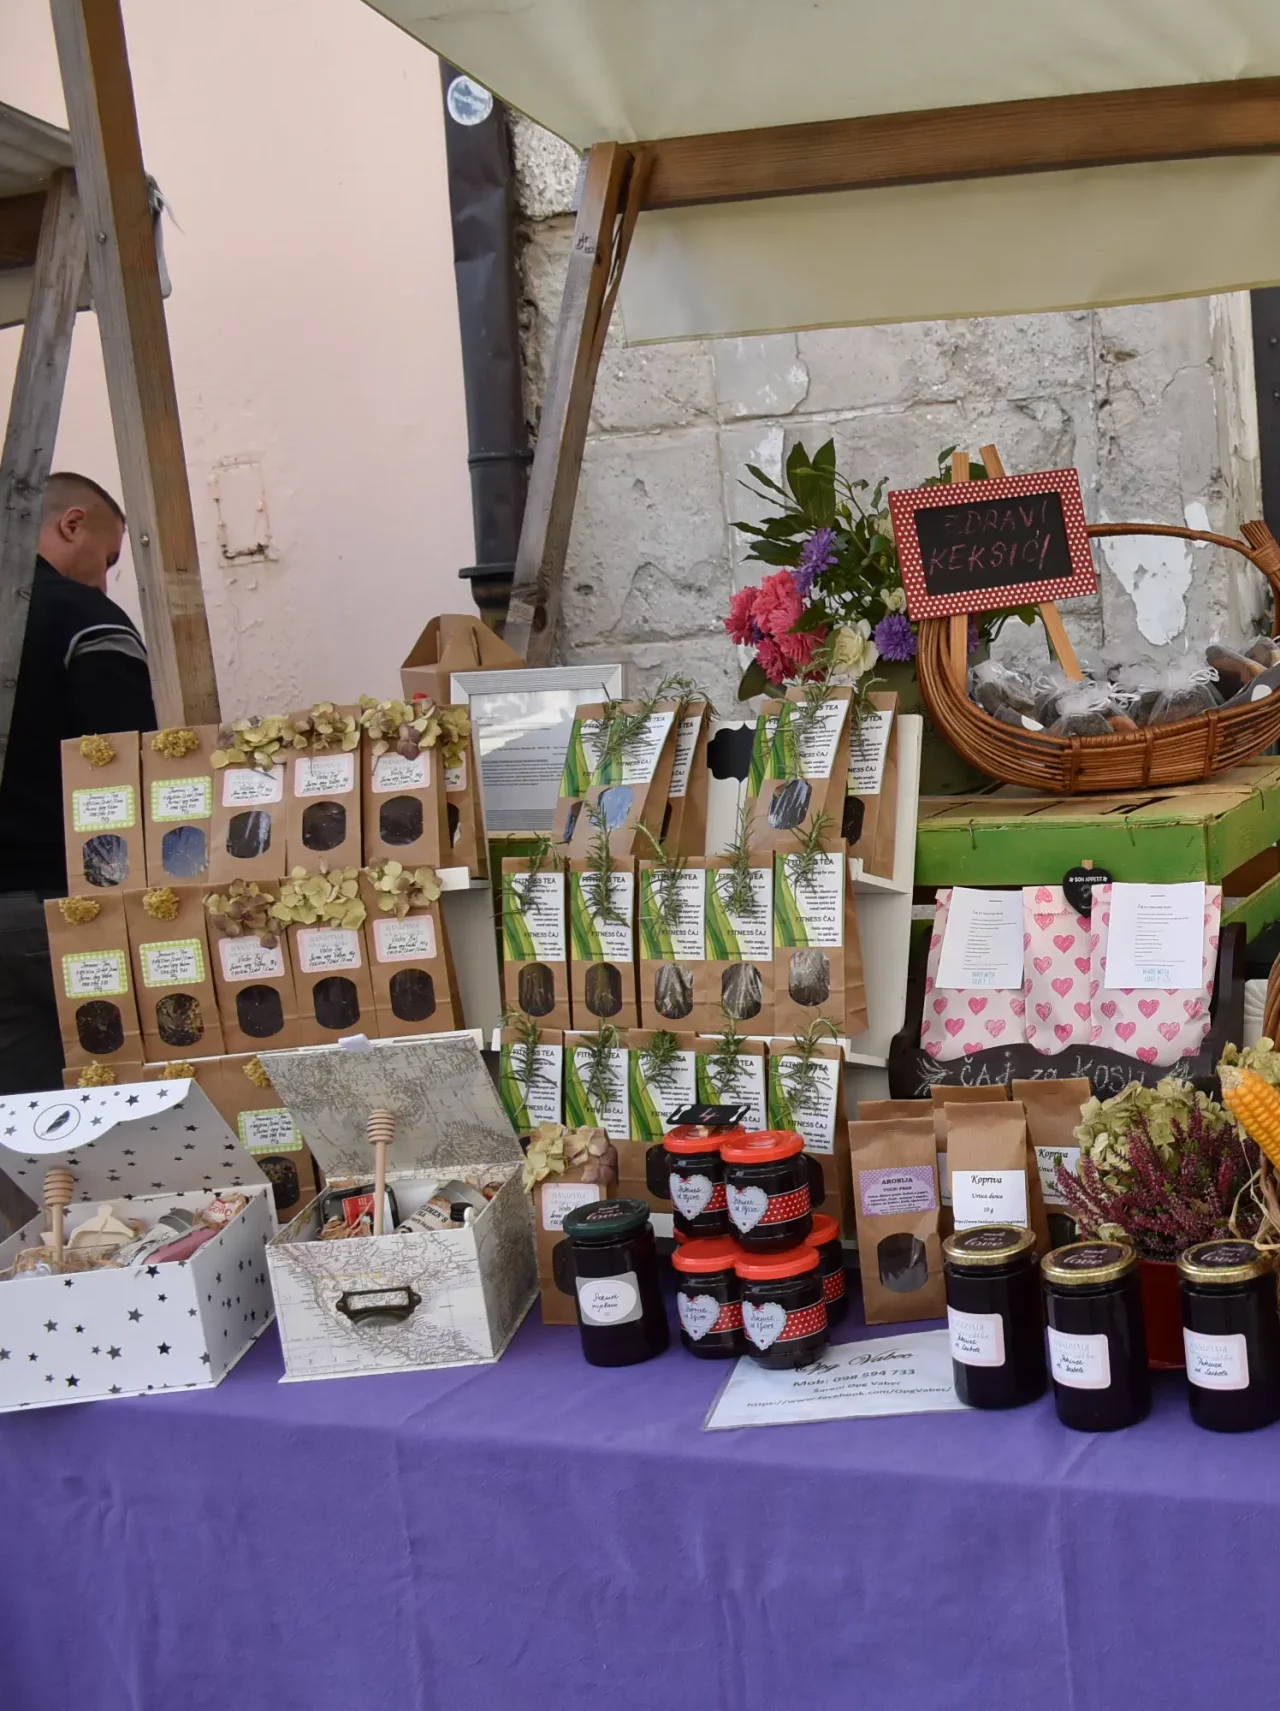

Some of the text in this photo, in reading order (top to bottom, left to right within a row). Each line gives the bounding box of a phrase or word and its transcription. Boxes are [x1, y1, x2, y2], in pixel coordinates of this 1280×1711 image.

[548, 930, 559, 938] ČAJ
[616, 930, 627, 938] ČAJ
[545, 1104, 555, 1112] ČAJ
[749, 1115, 760, 1123] ČAJ
[815, 1121, 827, 1129] ČAJ
[881, 1177, 913, 1185] ARONIJA
[971, 1175, 1003, 1186] Kopriva
[1063, 1255, 1103, 1265] love
[1201, 1251, 1240, 1263] love
[848, 1348, 914, 1365] Vabec
[793, 1379, 829, 1387] Mob:
[833, 1374, 858, 1383] 098
[891, 1368, 916, 1376] 733
